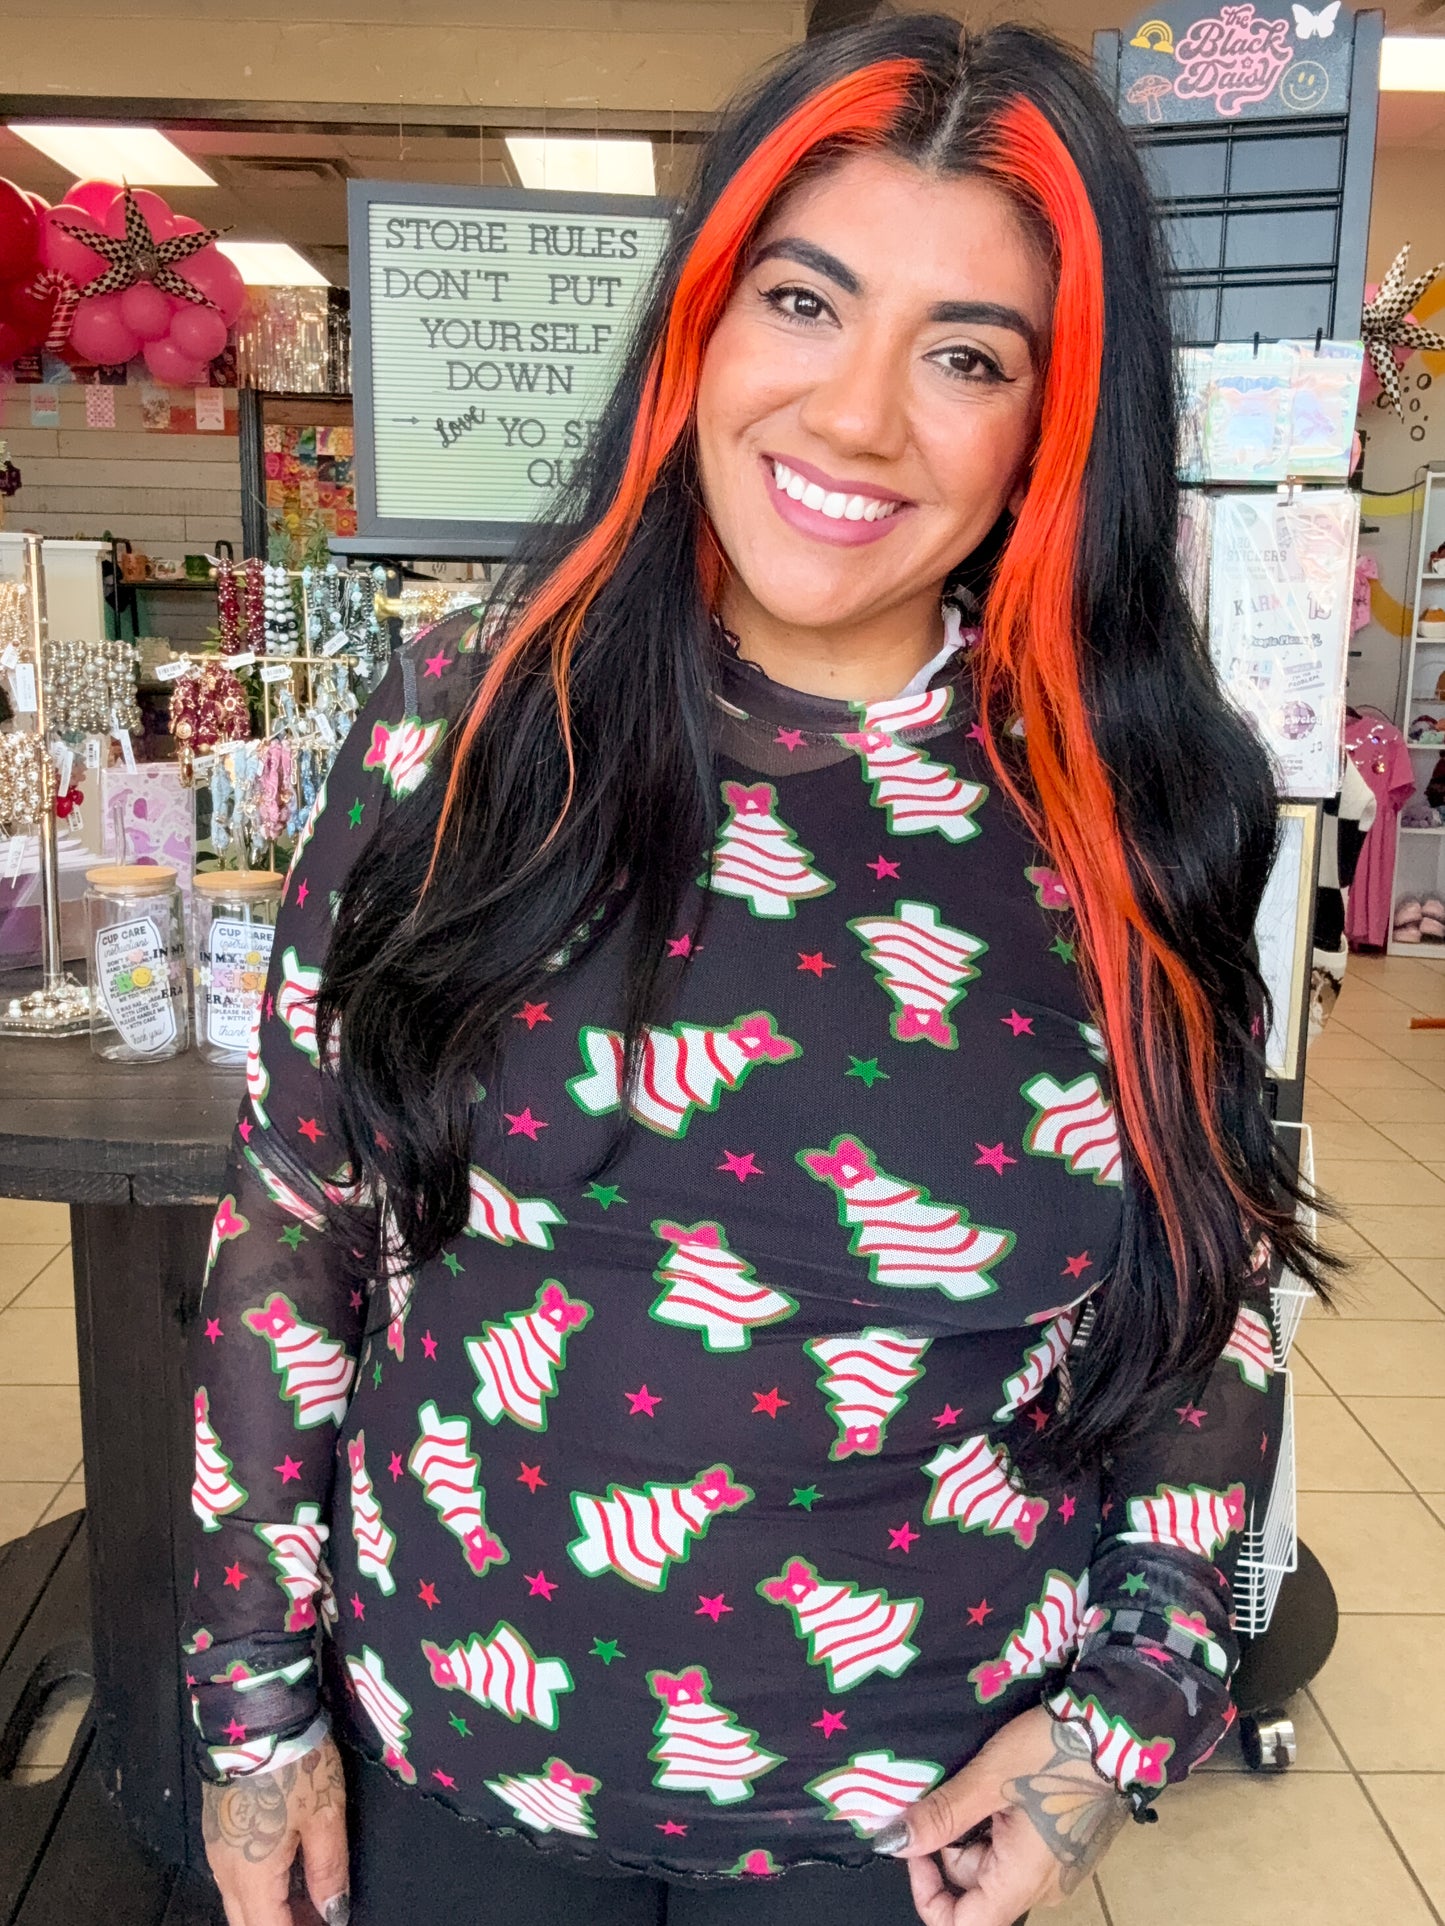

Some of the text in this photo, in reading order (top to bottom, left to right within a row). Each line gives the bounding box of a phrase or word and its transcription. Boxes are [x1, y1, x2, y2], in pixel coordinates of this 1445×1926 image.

[1178, 21, 1290, 61] Black
[1177, 57, 1281, 110] Daisy
[385, 217, 638, 259] STORE RULES
[383, 267, 622, 307] DON'T PUT
[420, 317, 612, 354] YOURSELF
[446, 361, 574, 394] DOWN
[497, 417, 546, 447] YO
[102, 926, 147, 945] CUP CARE
[219, 928, 241, 937] CUP
[153, 947, 168, 958] IN
[200, 951, 211, 962] IN
[161, 986, 184, 999] ERA
[205, 993, 233, 1005] ERA
